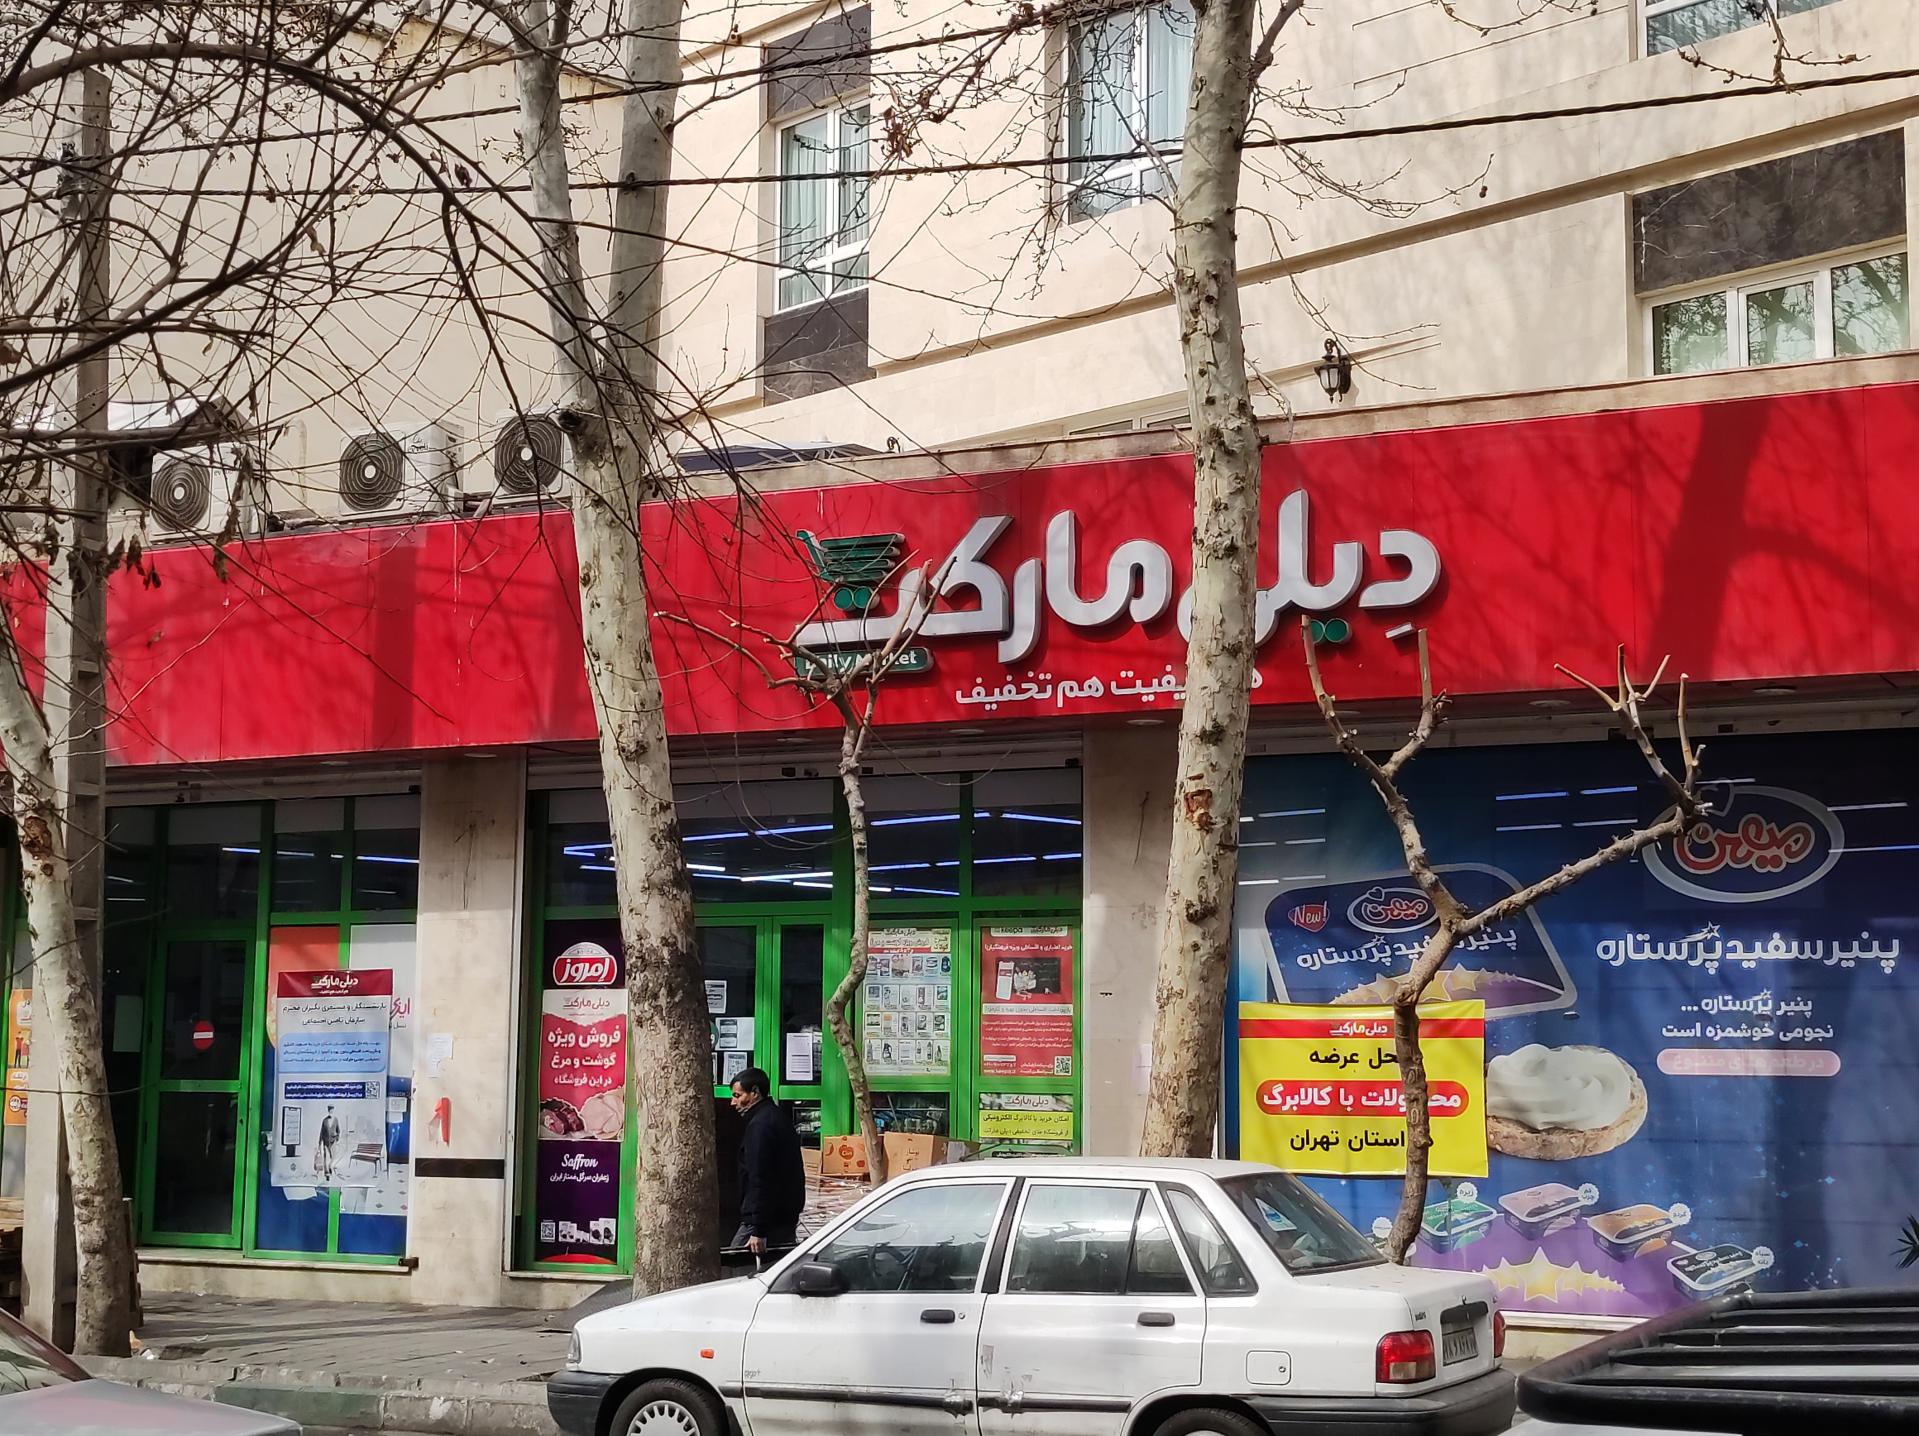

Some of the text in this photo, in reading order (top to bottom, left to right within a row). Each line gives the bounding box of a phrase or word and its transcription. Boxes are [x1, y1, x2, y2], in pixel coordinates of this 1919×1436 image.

[956, 664, 1186, 710] یفیت هم تخفیف
[1672, 813, 1815, 875] میهن
[1294, 901, 1328, 926] New!
[1362, 898, 1429, 923] میهن
[1726, 931, 1823, 968] سفید
[1823, 931, 1900, 974] پنیر
[1775, 996, 1812, 1018] پنیر
[547, 1025, 621, 1048] فروش ویژه
[1662, 1022, 1834, 1041] نجومی خوشمزه است
[550, 1051, 616, 1069] گوشت و مرغ
[1309, 1048, 1400, 1070] حل عرضه
[554, 1073, 612, 1087] در این فروشگاه
[1263, 1084, 1461, 1112] محولات با کالابرگ
[1290, 1129, 1340, 1151] تهران
[1348, 1130, 1405, 1150] استان
[561, 1153, 598, 1171] Saffron
